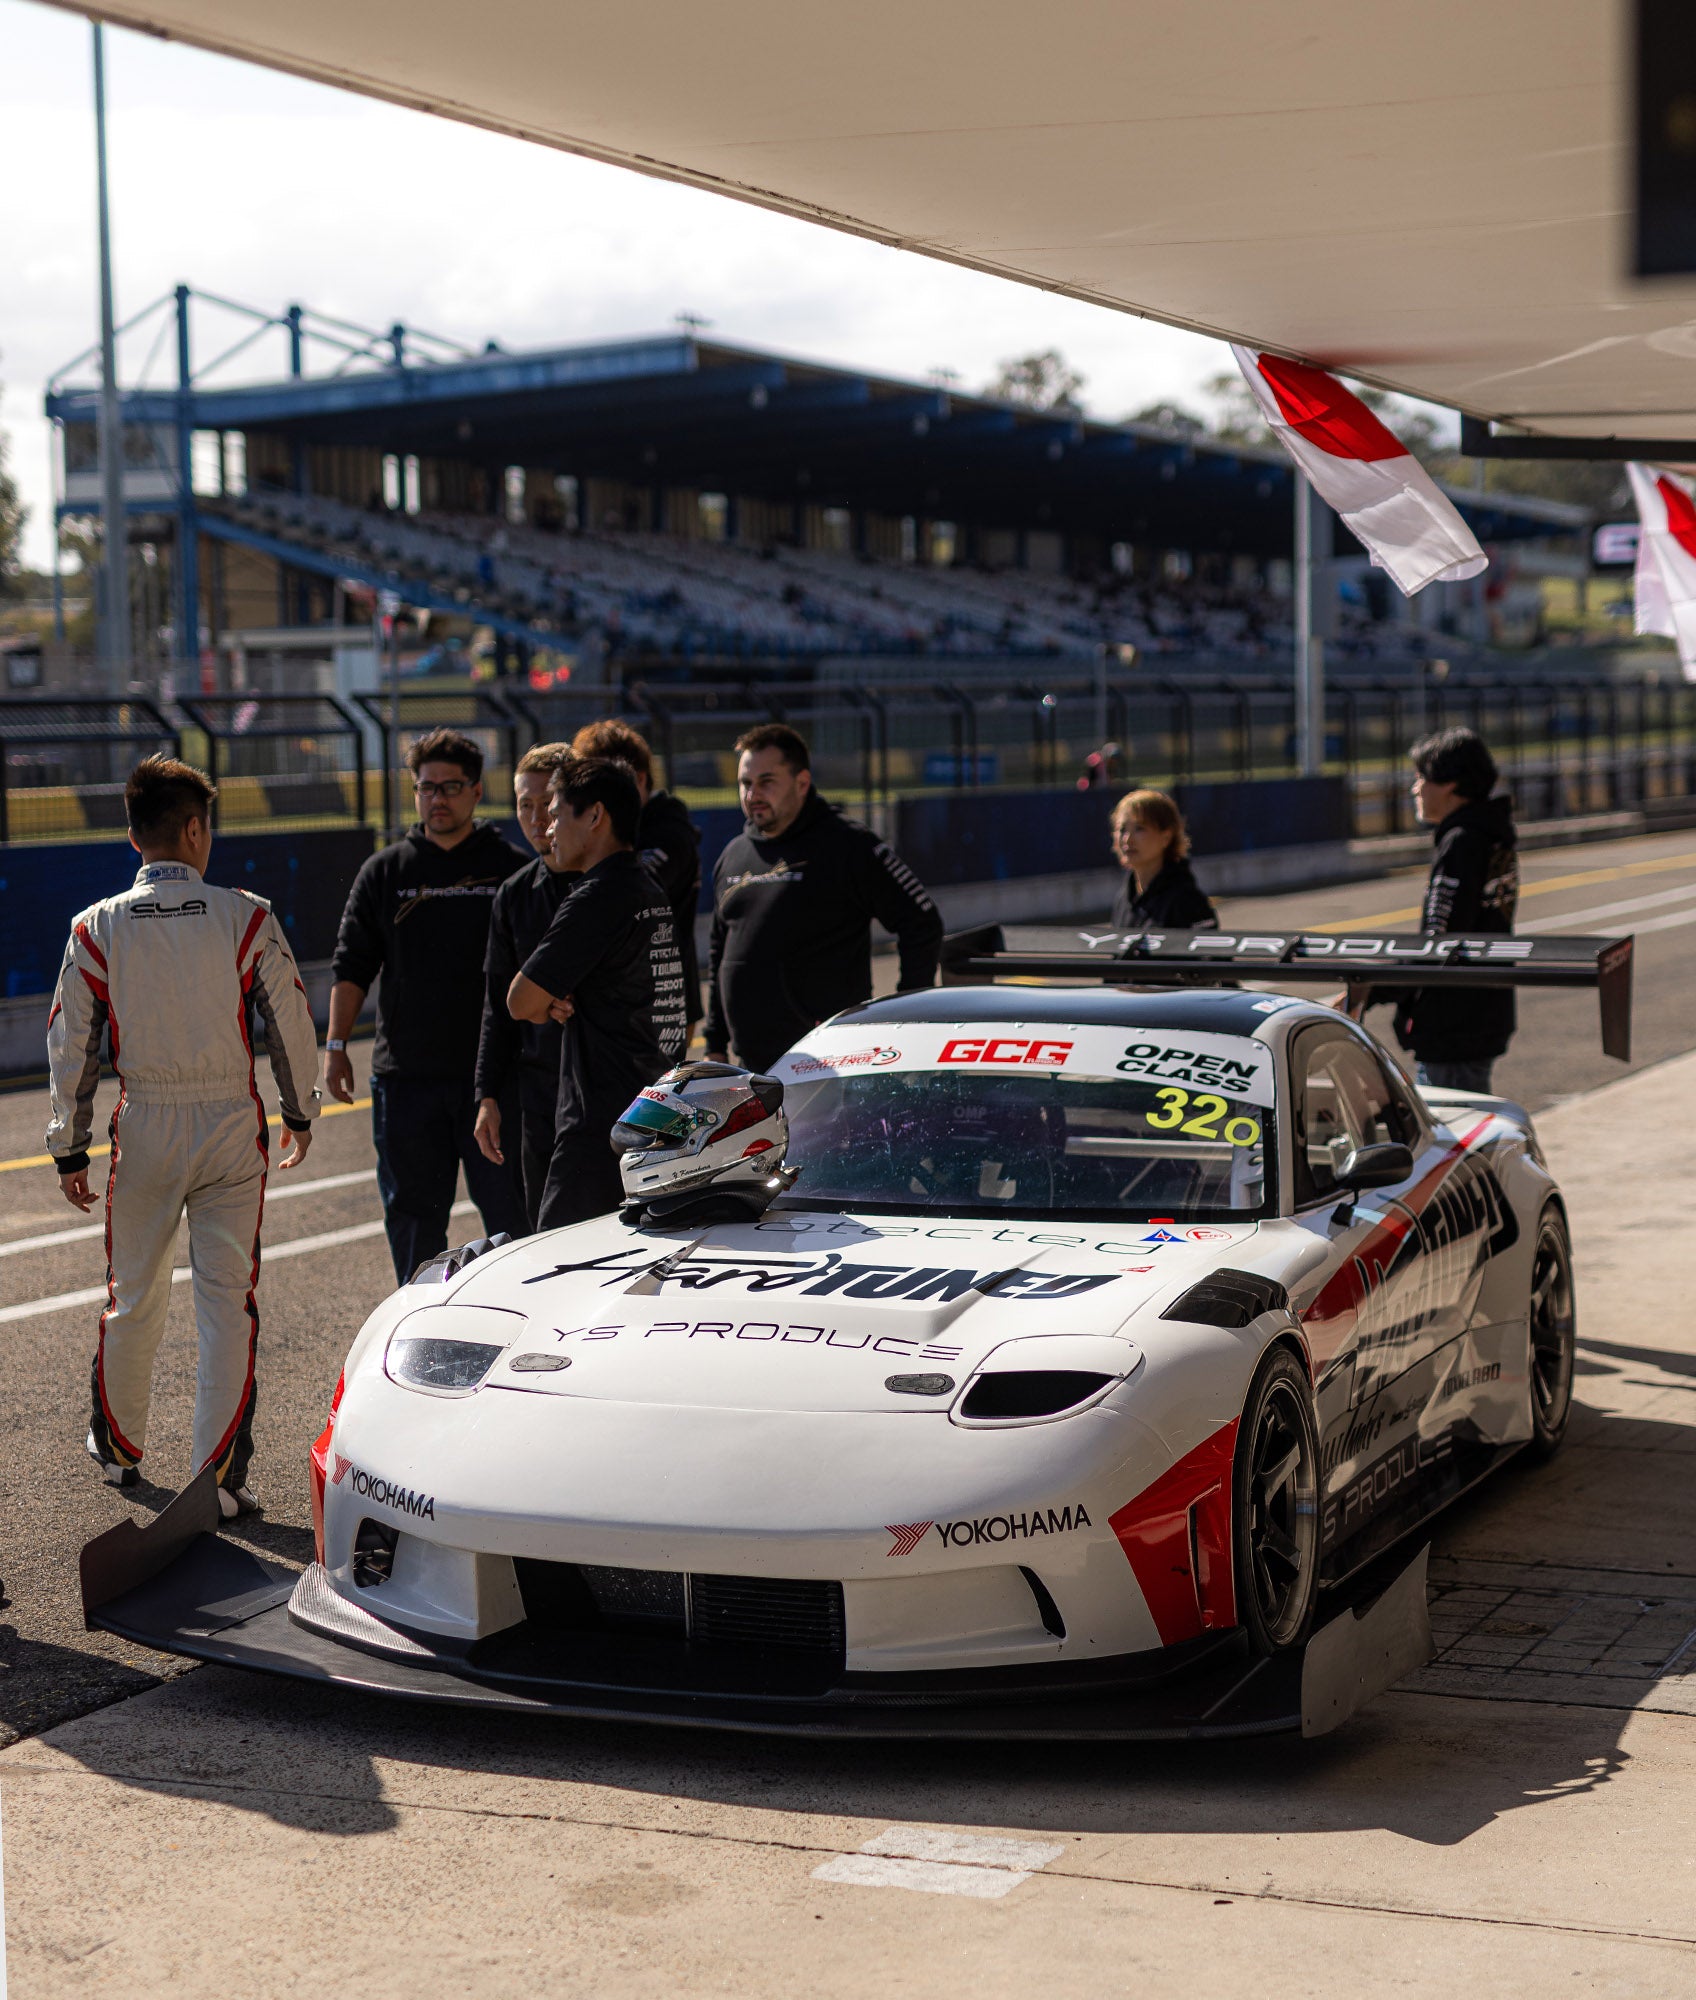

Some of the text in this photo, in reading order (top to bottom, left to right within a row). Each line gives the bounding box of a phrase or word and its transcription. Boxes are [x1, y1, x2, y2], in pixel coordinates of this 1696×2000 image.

[130, 900, 207, 914] CLA
[421, 886, 497, 897] PRODUCE
[1078, 932, 1534, 959] YS PRODUCE
[937, 1038, 1074, 1066] GCG
[1124, 1043, 1259, 1079] OPEN
[1116, 1059, 1252, 1093] CLASS
[628, 1218, 1164, 1255] otected
[552, 1321, 963, 1361] YS PRODUCE
[1344, 1424, 1453, 1525] PRODUCE
[351, 1466, 435, 1521] YOKOHAMA
[935, 1503, 1092, 1548] YOKOHAMA
